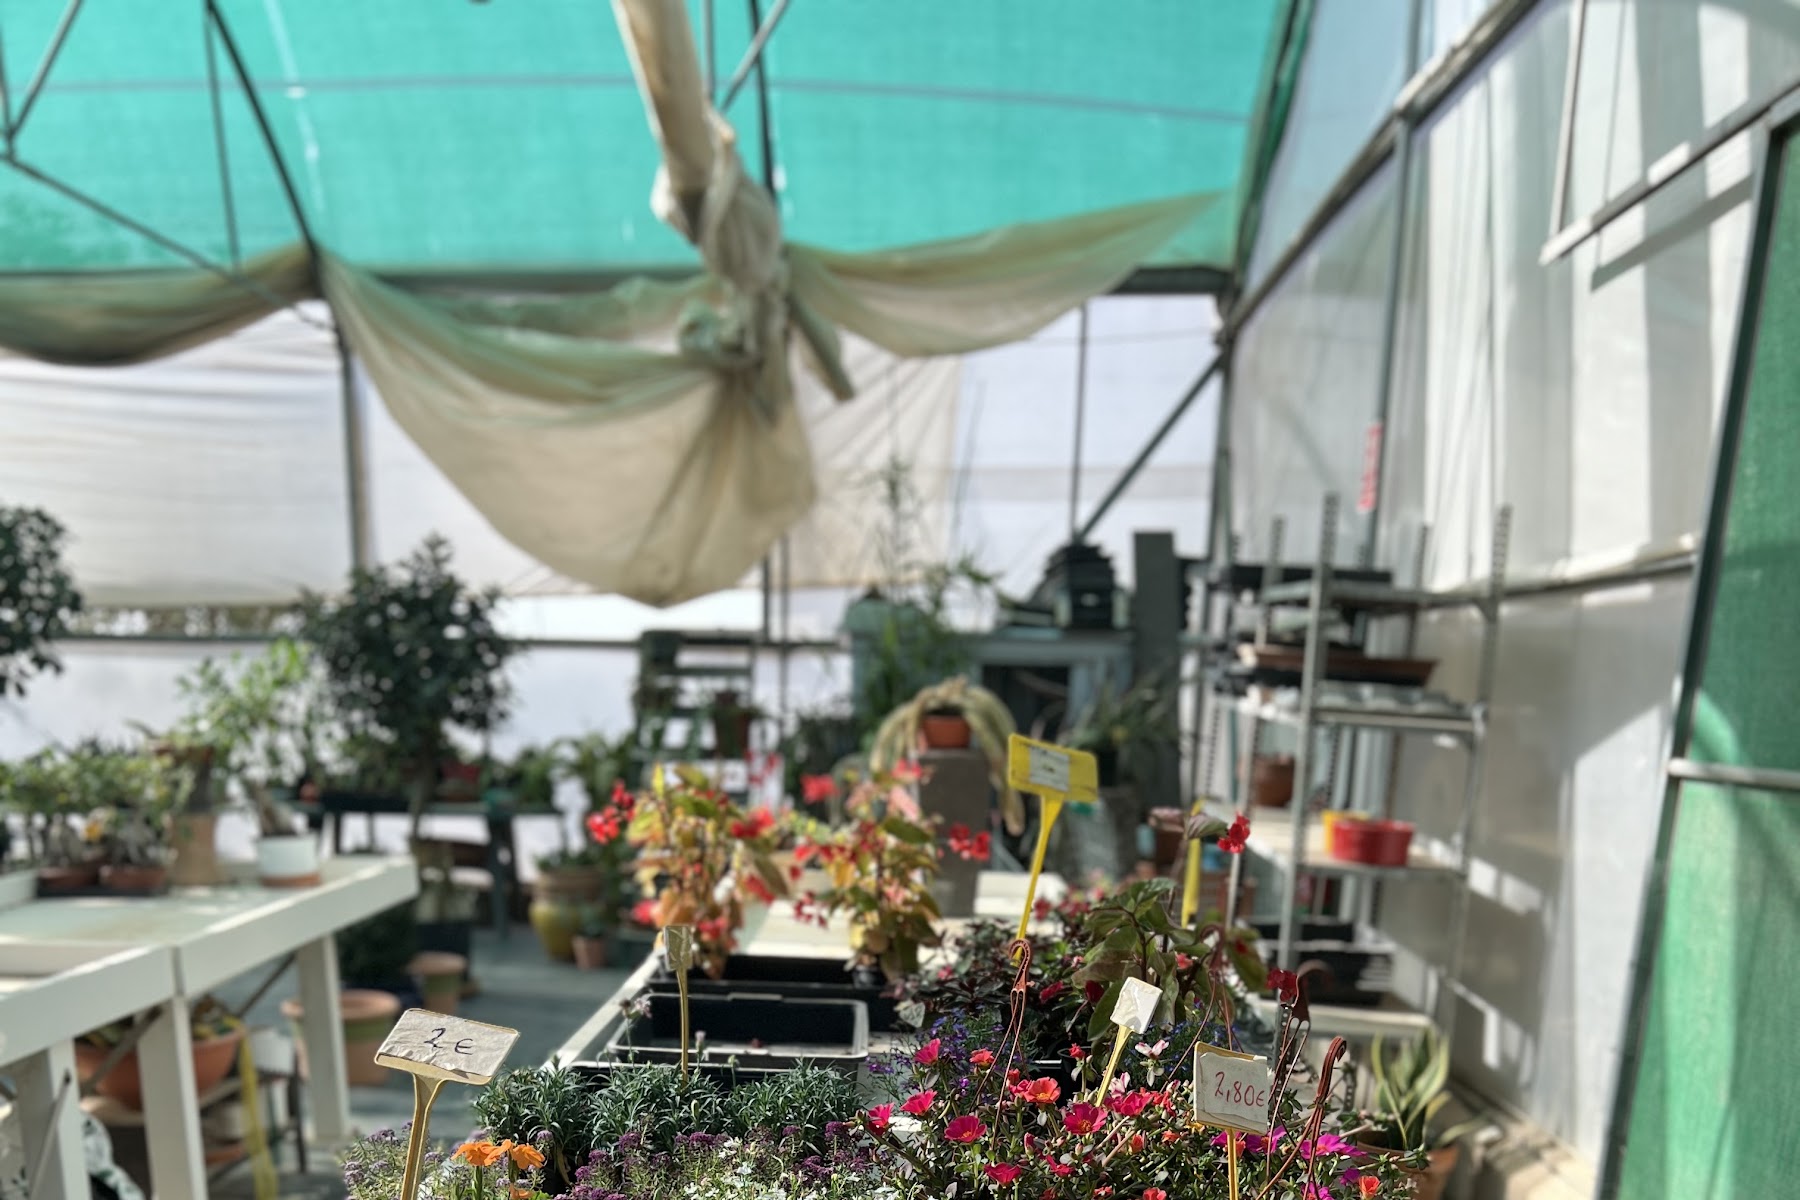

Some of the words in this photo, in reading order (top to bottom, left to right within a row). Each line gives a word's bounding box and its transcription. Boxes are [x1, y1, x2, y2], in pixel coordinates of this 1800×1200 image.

[424, 1027, 446, 1050] 2
[454, 1038, 474, 1056] €
[1214, 1071, 1265, 1108] 2,80€
